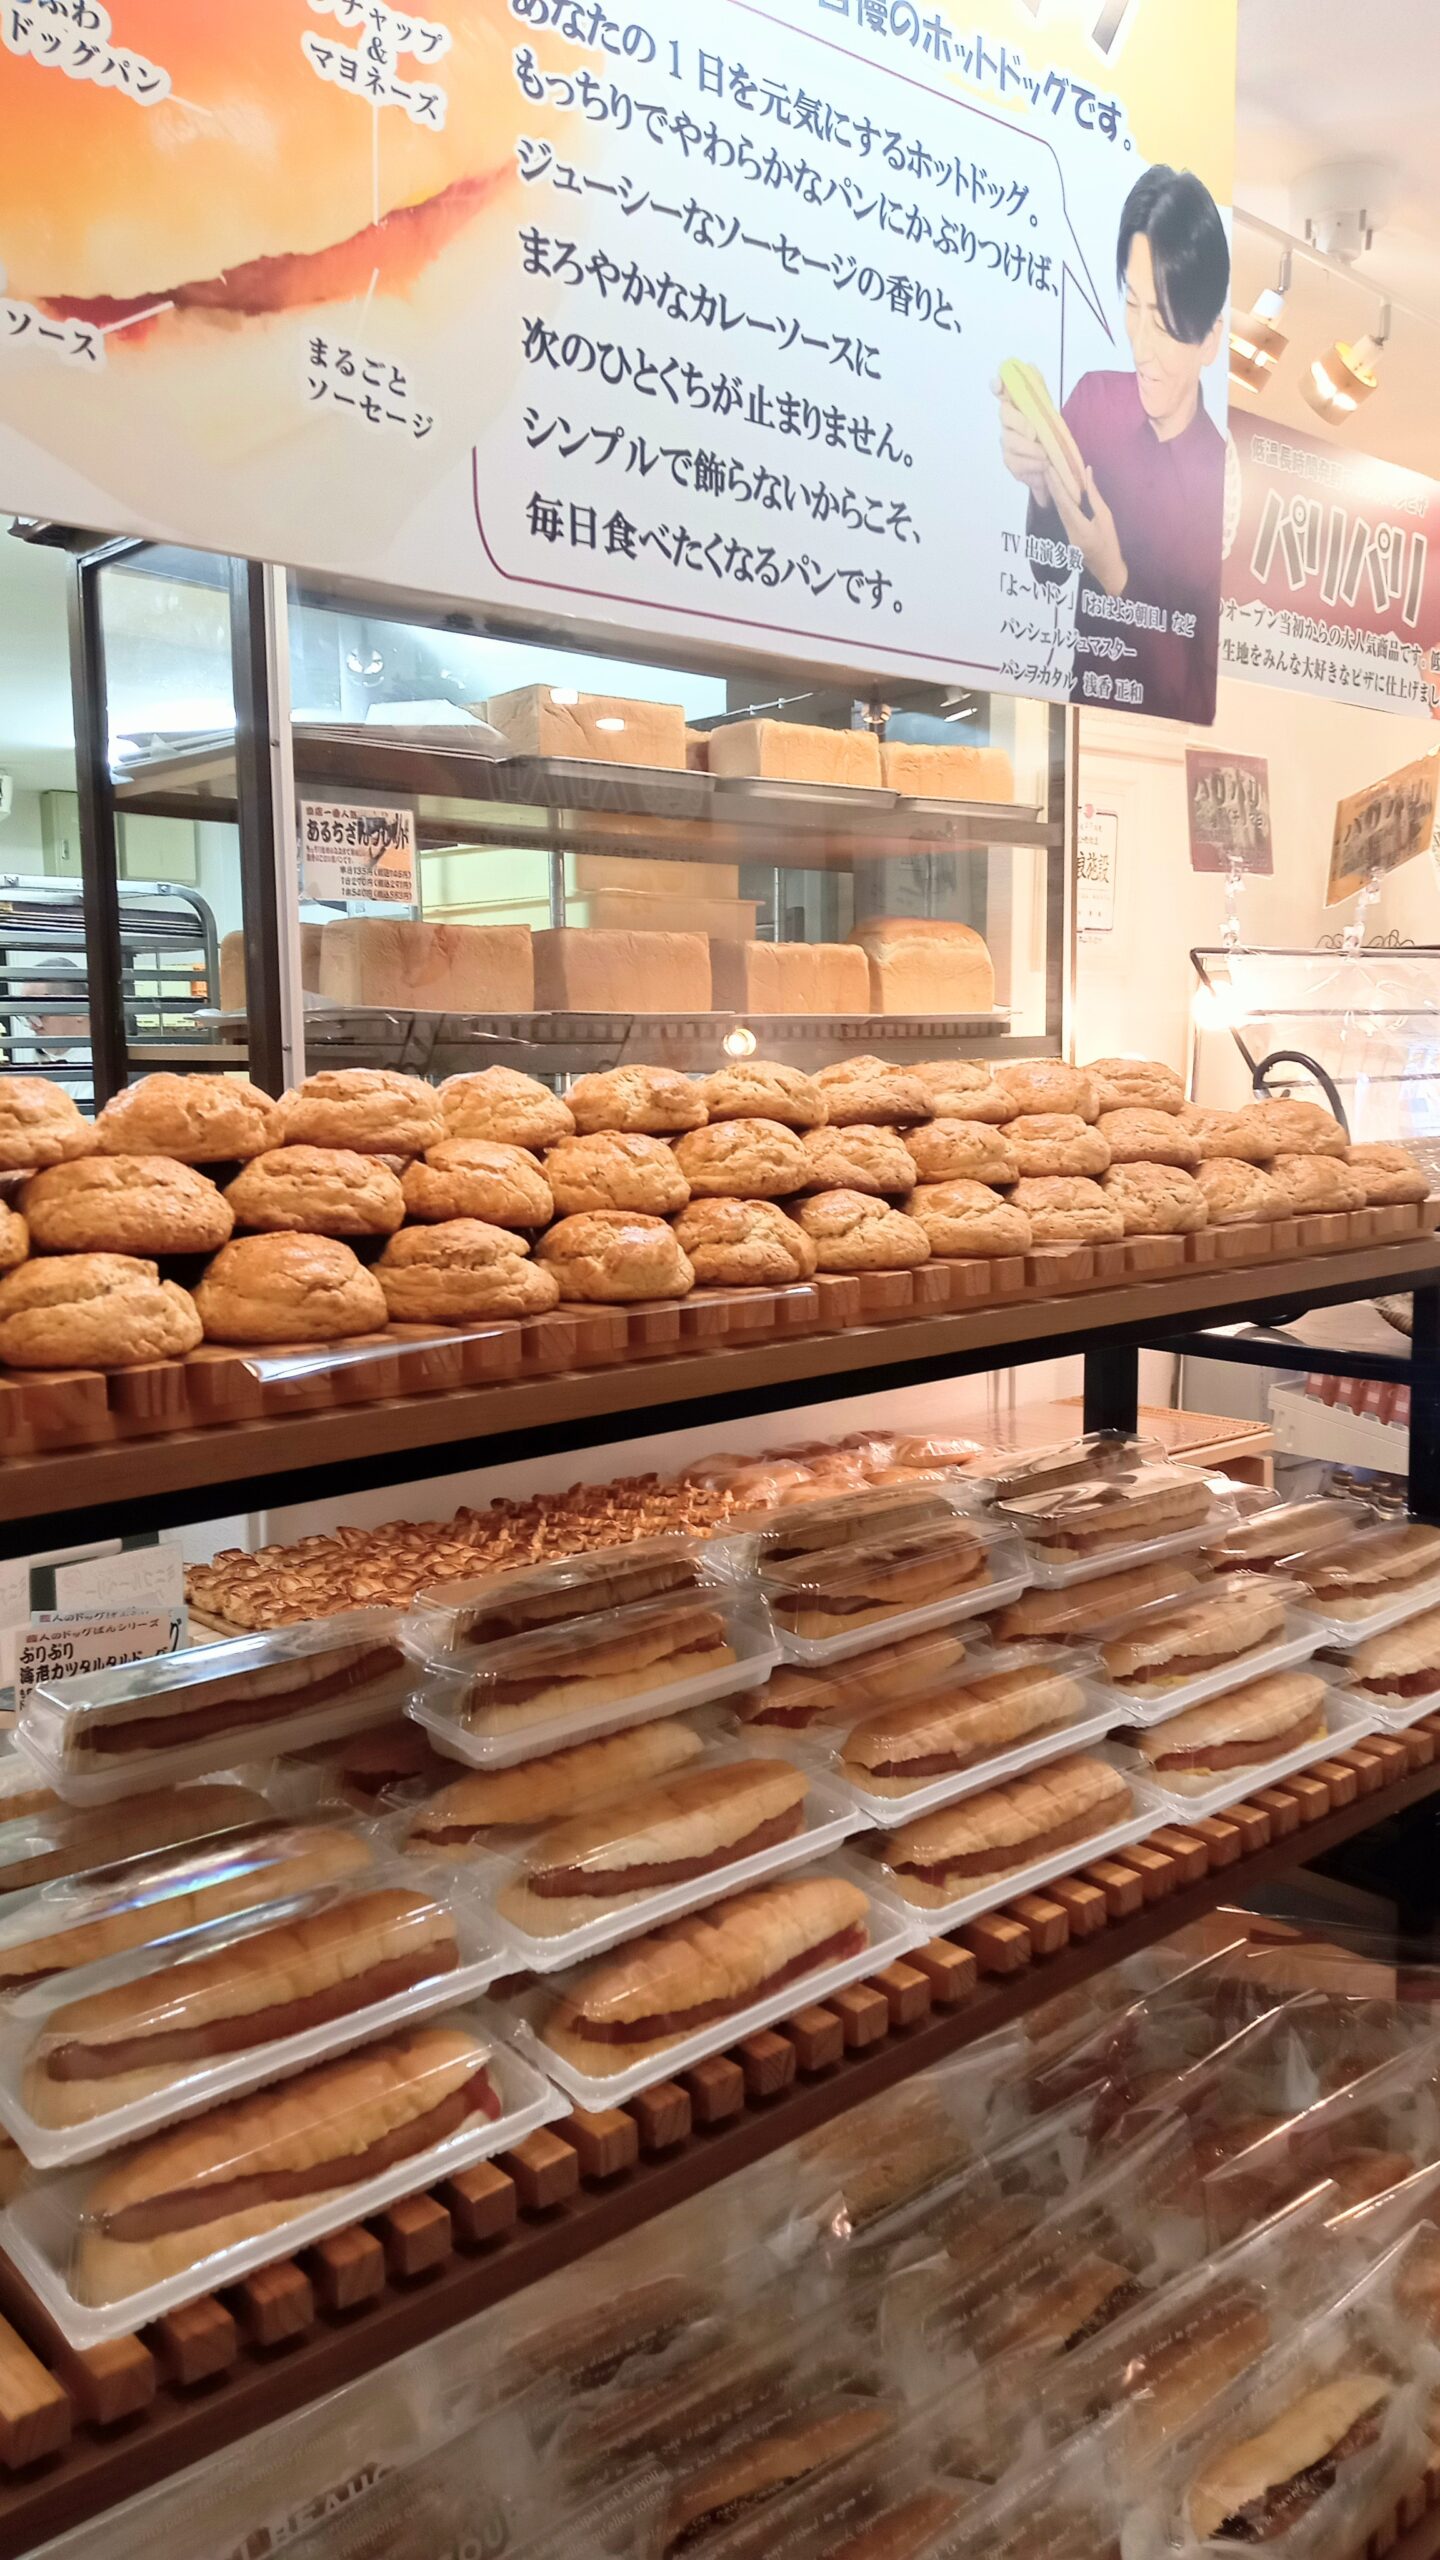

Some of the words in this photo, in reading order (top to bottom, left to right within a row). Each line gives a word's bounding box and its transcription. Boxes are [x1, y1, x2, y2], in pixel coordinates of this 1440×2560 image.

[12, 9, 160, 93] ドッグパン
[310, 43, 440, 120] マヨネーズ
[367, 36, 388, 64] &
[515, 48, 1060, 297] もっちりでやわらかなパンにかぶりつけば、
[516, 138, 963, 334] ジューシーなソーセージの香りと、
[6, 311, 98, 361] ソース
[518, 226, 882, 381] まろやかなカレーソースに
[309, 337, 408, 398] まるごと
[521, 316, 914, 468] 次のひとくちが止まりません。
[308, 378, 435, 439] ソーセージ
[523, 407, 921, 544] シンプルで飾らないからこそ、
[526, 491, 903, 614] 毎日食べたくなるパンです。
[1001, 532, 1021, 552] TV
[1025, 535, 1084, 572] 出演多数
[1251, 488, 1427, 628] パリパリ
[1000, 617, 1138, 661] パンシェルジュマスター
[1171, 610, 1198, 638] など
